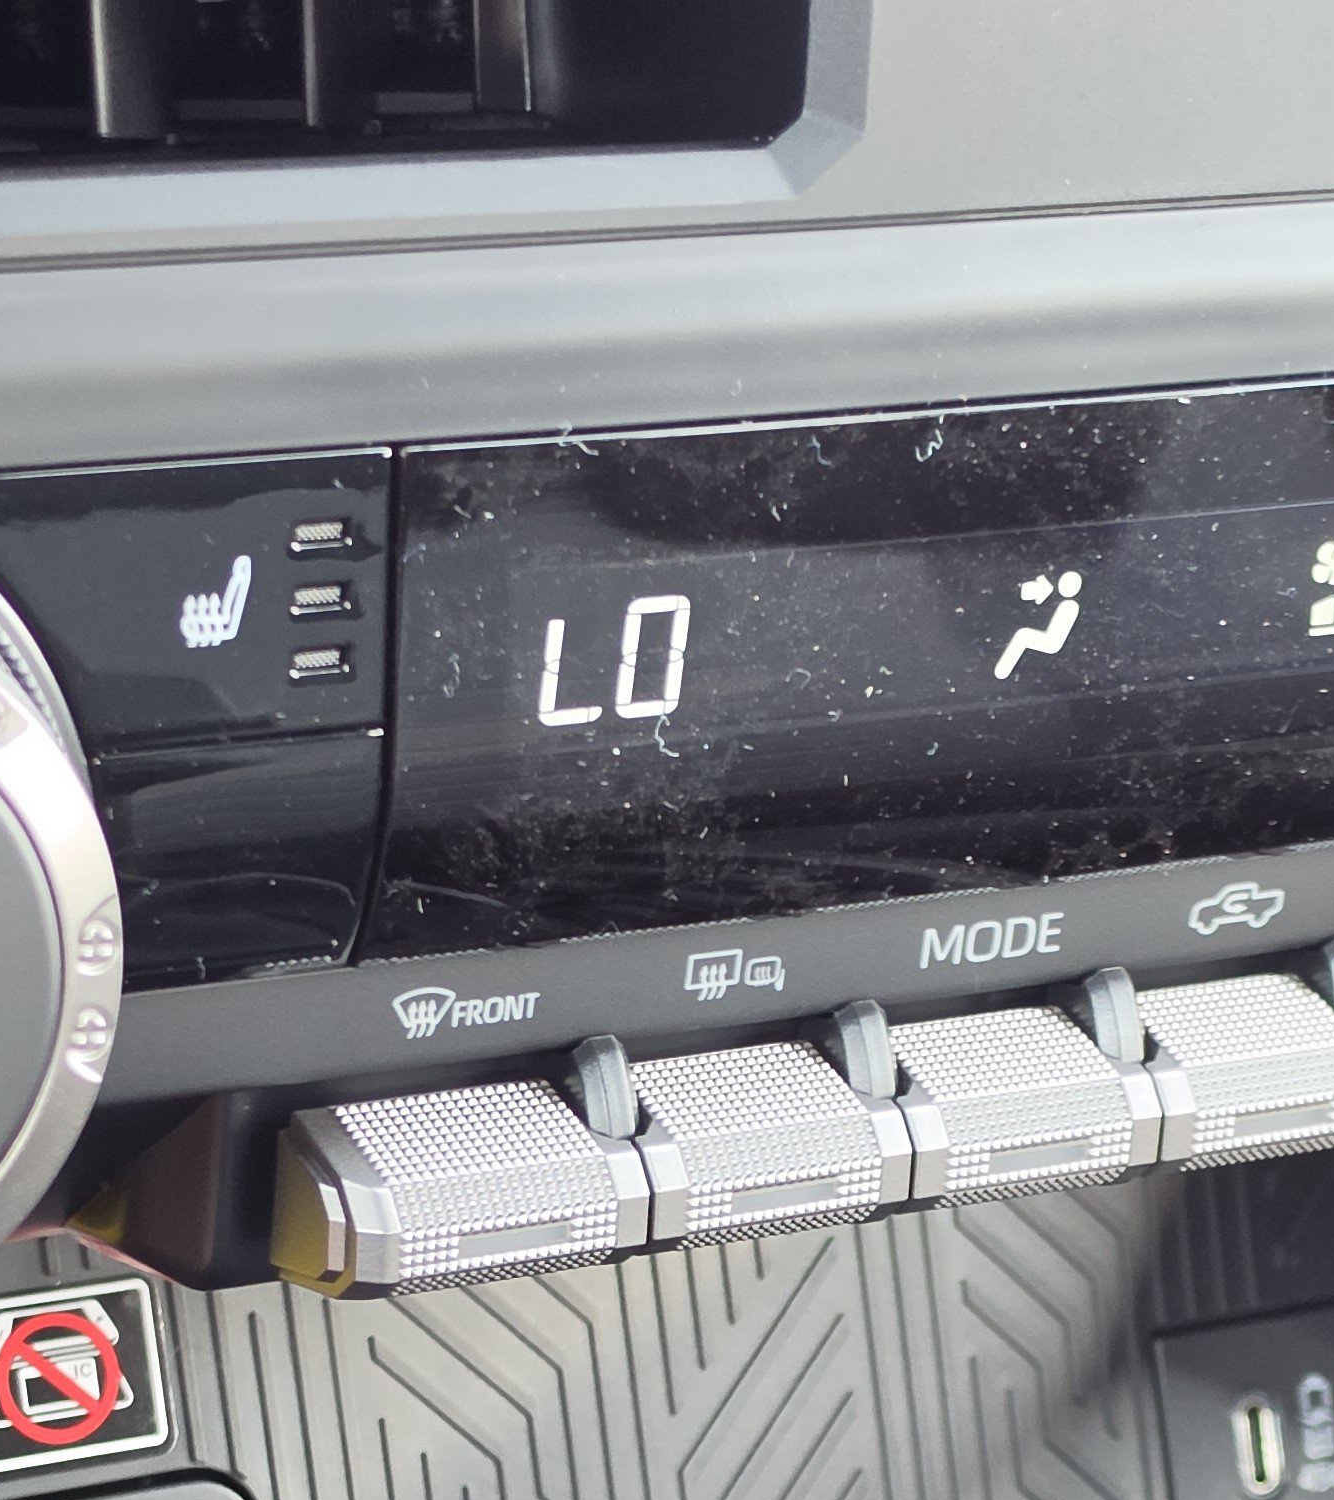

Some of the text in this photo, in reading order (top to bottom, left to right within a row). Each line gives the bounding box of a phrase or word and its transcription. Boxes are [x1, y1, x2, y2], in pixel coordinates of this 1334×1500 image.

[538, 595, 691, 726] LO
[919, 912, 1065, 969] MODE
[451, 992, 540, 1028] FRONT
